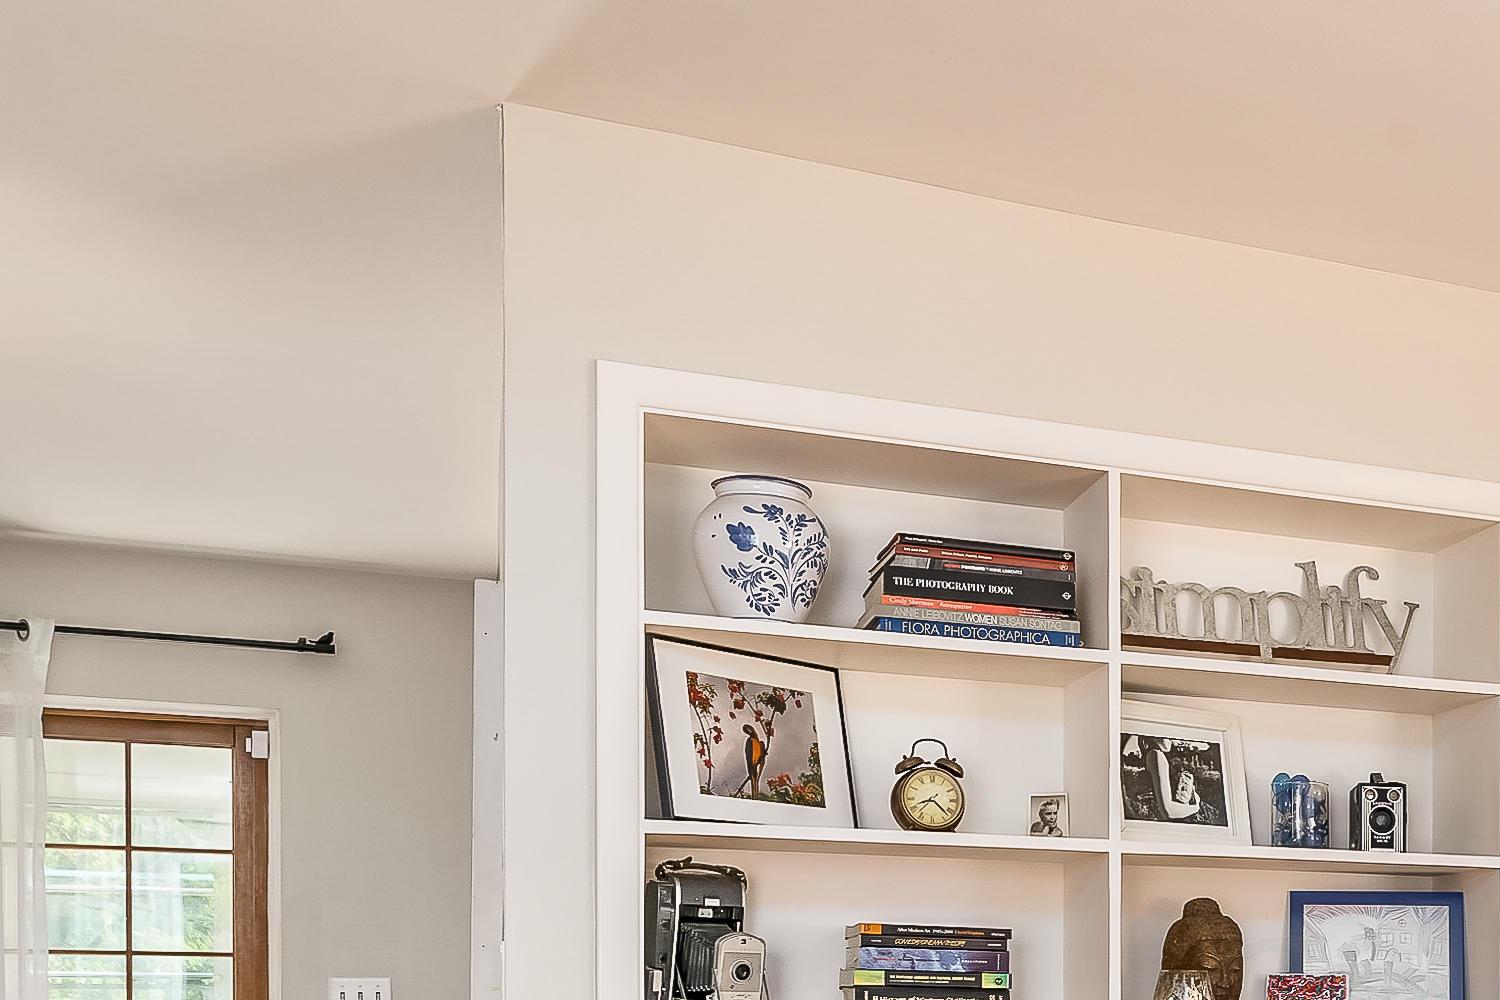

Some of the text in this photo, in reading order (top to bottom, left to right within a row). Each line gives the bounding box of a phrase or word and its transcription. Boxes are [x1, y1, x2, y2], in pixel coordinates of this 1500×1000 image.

[892, 576, 1014, 596] THE PHOTOGRAPHY BOOK
[893, 607, 919, 618] ANNIE
[963, 613, 998, 625] WOMEN
[998, 616, 1028, 627] SUSAN
[1028, 619, 1062, 630] SONTAG
[901, 621, 1051, 645] FLORA PHOTOGRAPHICA
